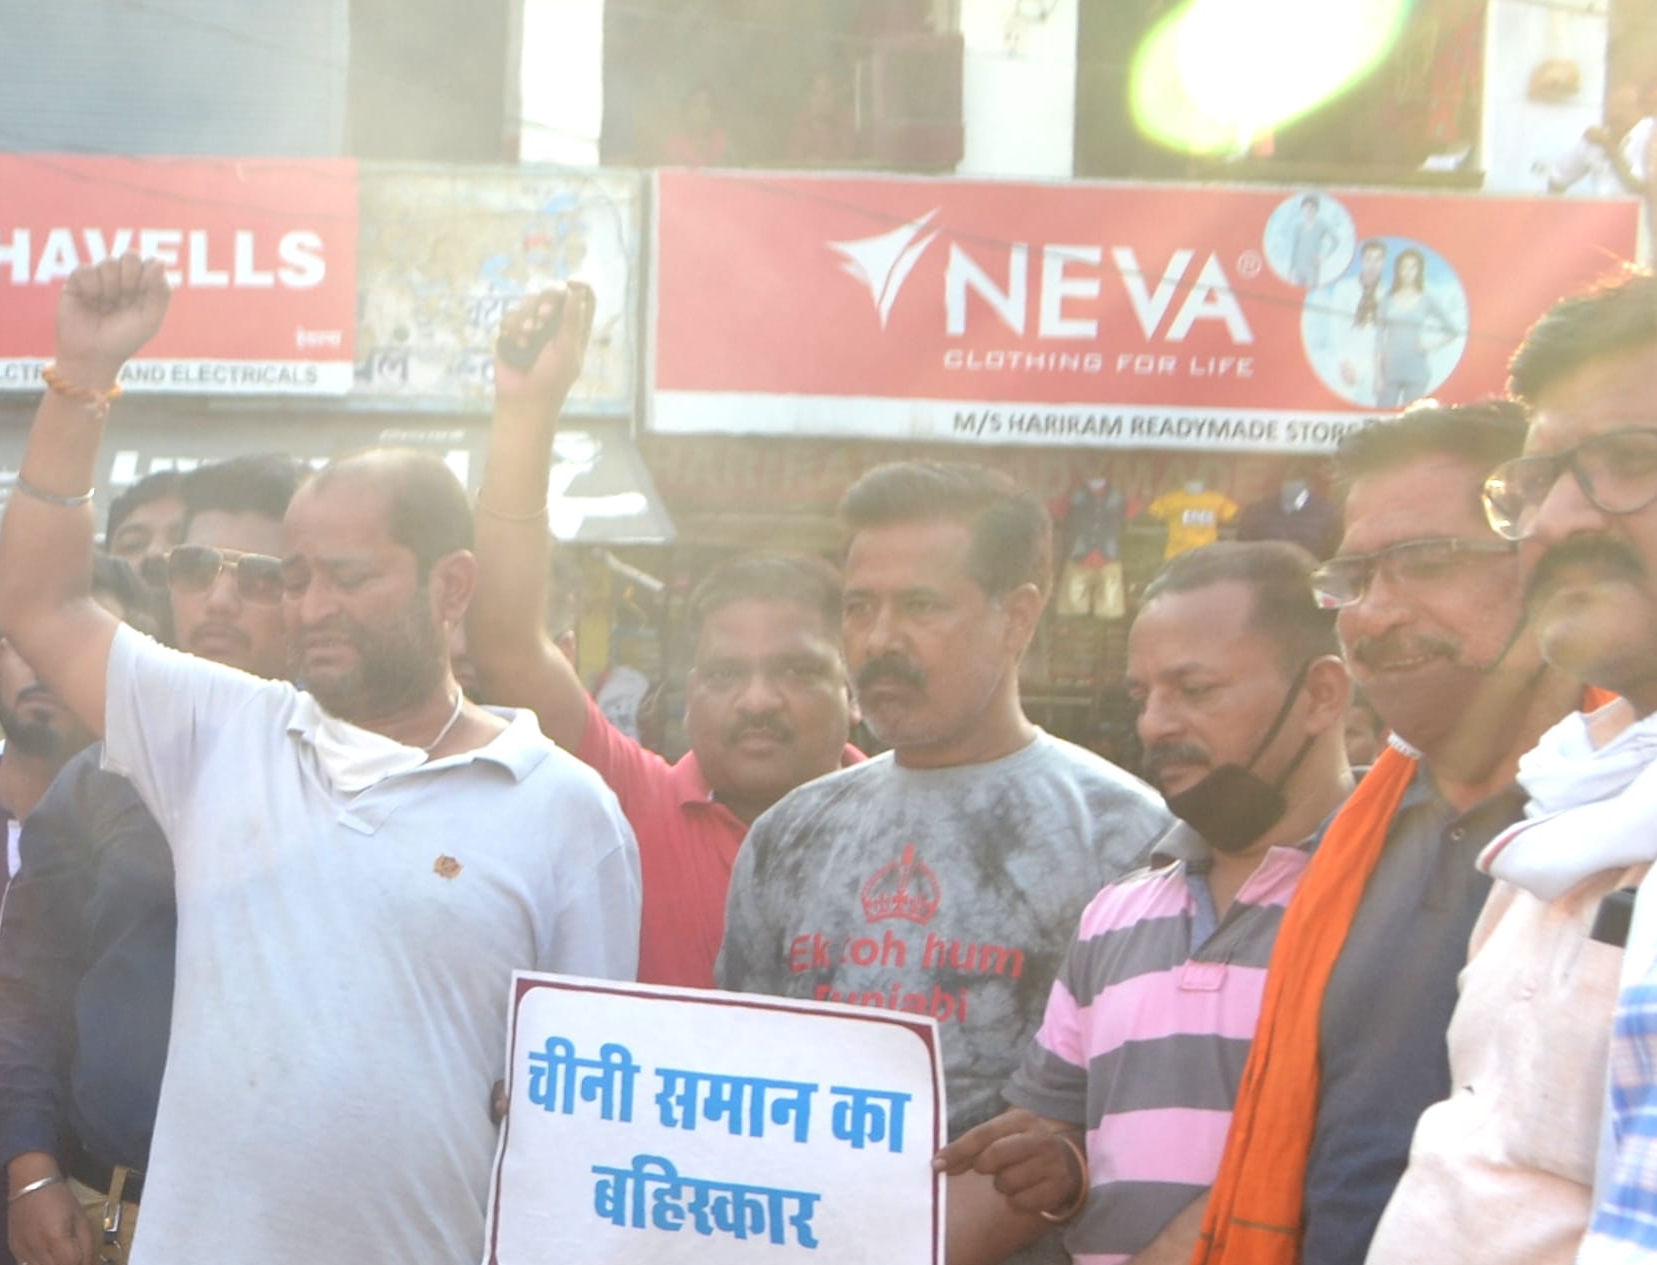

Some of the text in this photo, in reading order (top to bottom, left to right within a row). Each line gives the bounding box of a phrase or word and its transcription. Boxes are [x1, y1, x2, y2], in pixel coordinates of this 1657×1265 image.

[944, 240, 1254, 344] NEVA
[120, 365, 166, 383] AND
[170, 365, 319, 386] ELECTRICALS
[944, 349, 1255, 379] CLOTHING FOR LIFE
[952, 410, 1002, 438] M/S
[1007, 412, 1123, 437] HARIRAM
[1130, 415, 1280, 442] READYMADE
[789, 931, 834, 974] Ek
[921, 931, 1025, 980] hum
[527, 1035, 913, 1154] चीनी समान का
